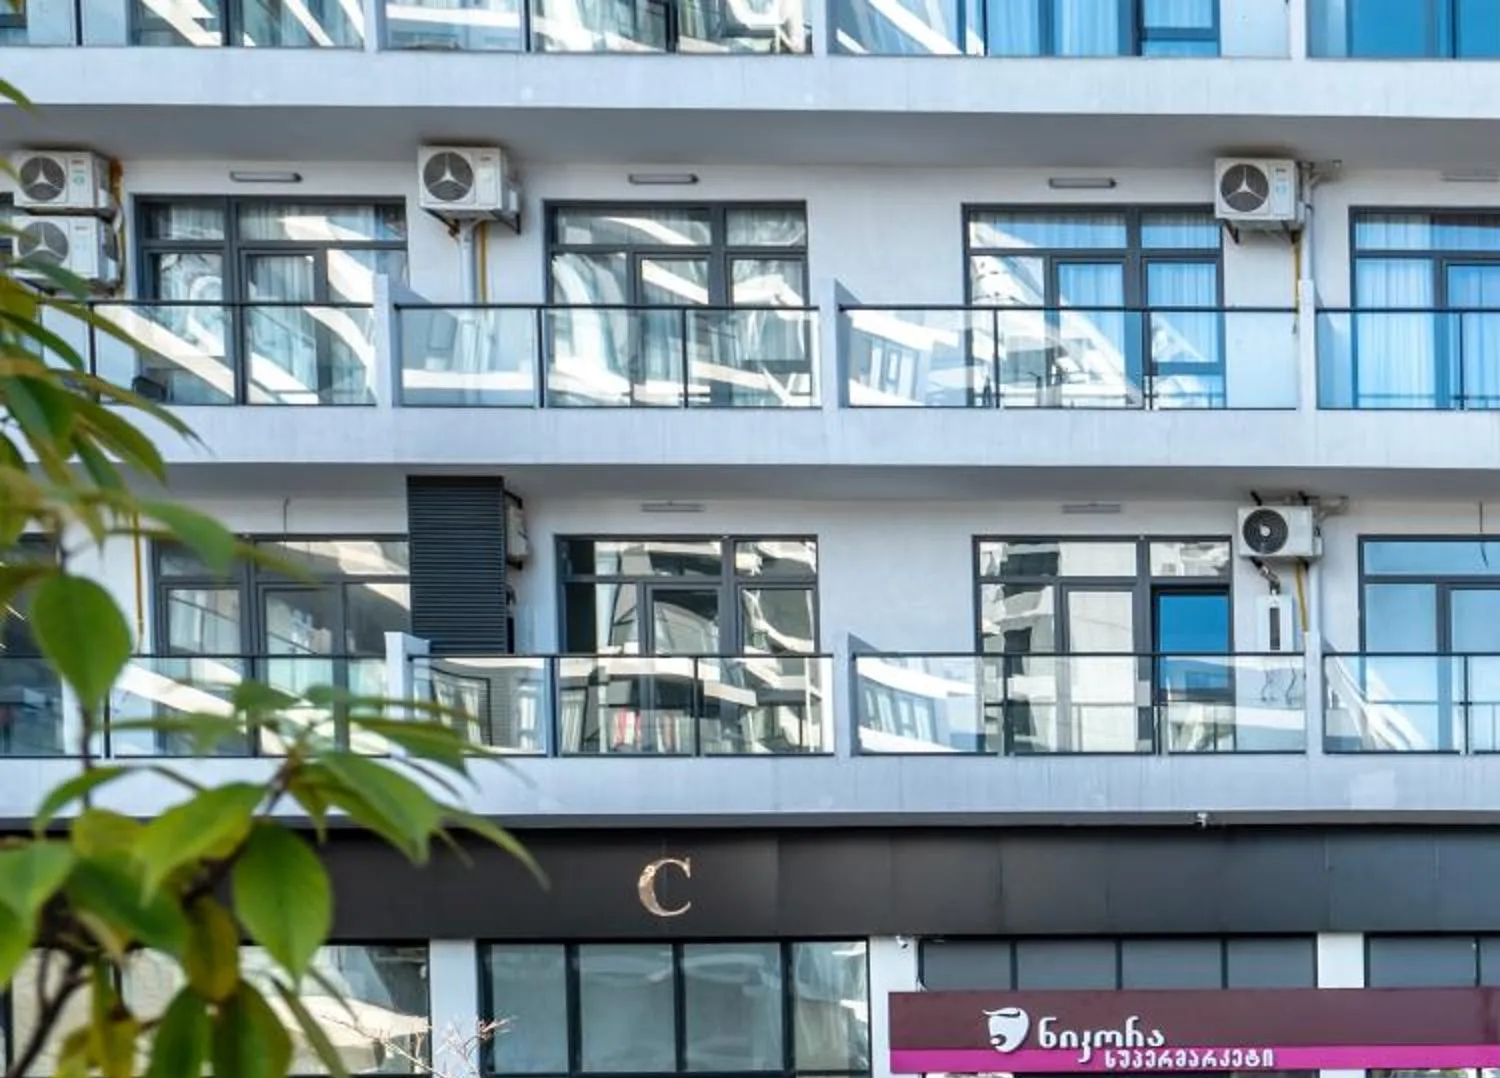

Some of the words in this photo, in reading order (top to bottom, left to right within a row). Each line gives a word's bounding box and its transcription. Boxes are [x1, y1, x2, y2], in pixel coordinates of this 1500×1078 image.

[637, 857, 692, 916] C
[1038, 1016, 1166, 1064] ნიკორა
[1104, 1048, 1275, 1069] სუპერმარკეტი
